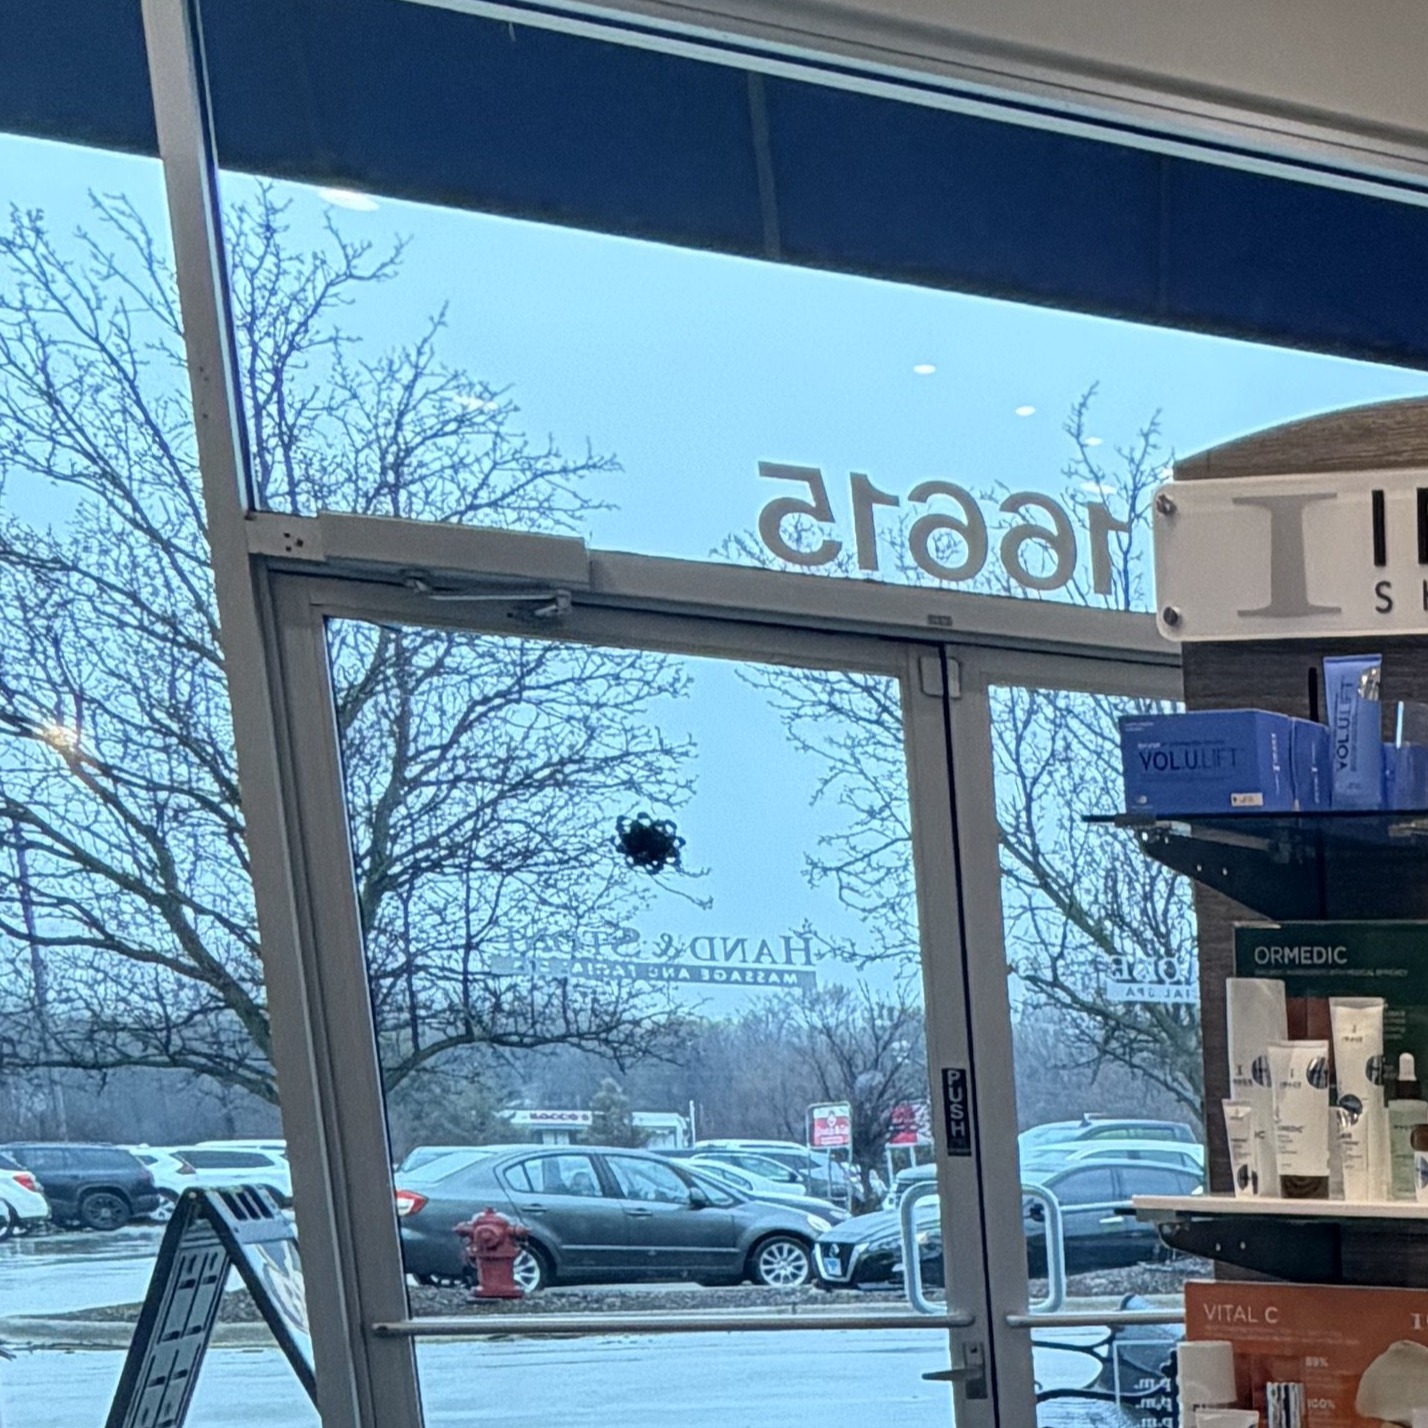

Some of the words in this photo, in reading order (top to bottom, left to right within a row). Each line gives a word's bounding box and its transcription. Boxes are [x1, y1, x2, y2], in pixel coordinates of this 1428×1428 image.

[1253, 945, 1349, 966] ORMEDIC
[946, 1069, 966, 1137] PUSH
[1203, 1303, 1259, 1324] VITAL
[1264, 1306, 1279, 1324] C
